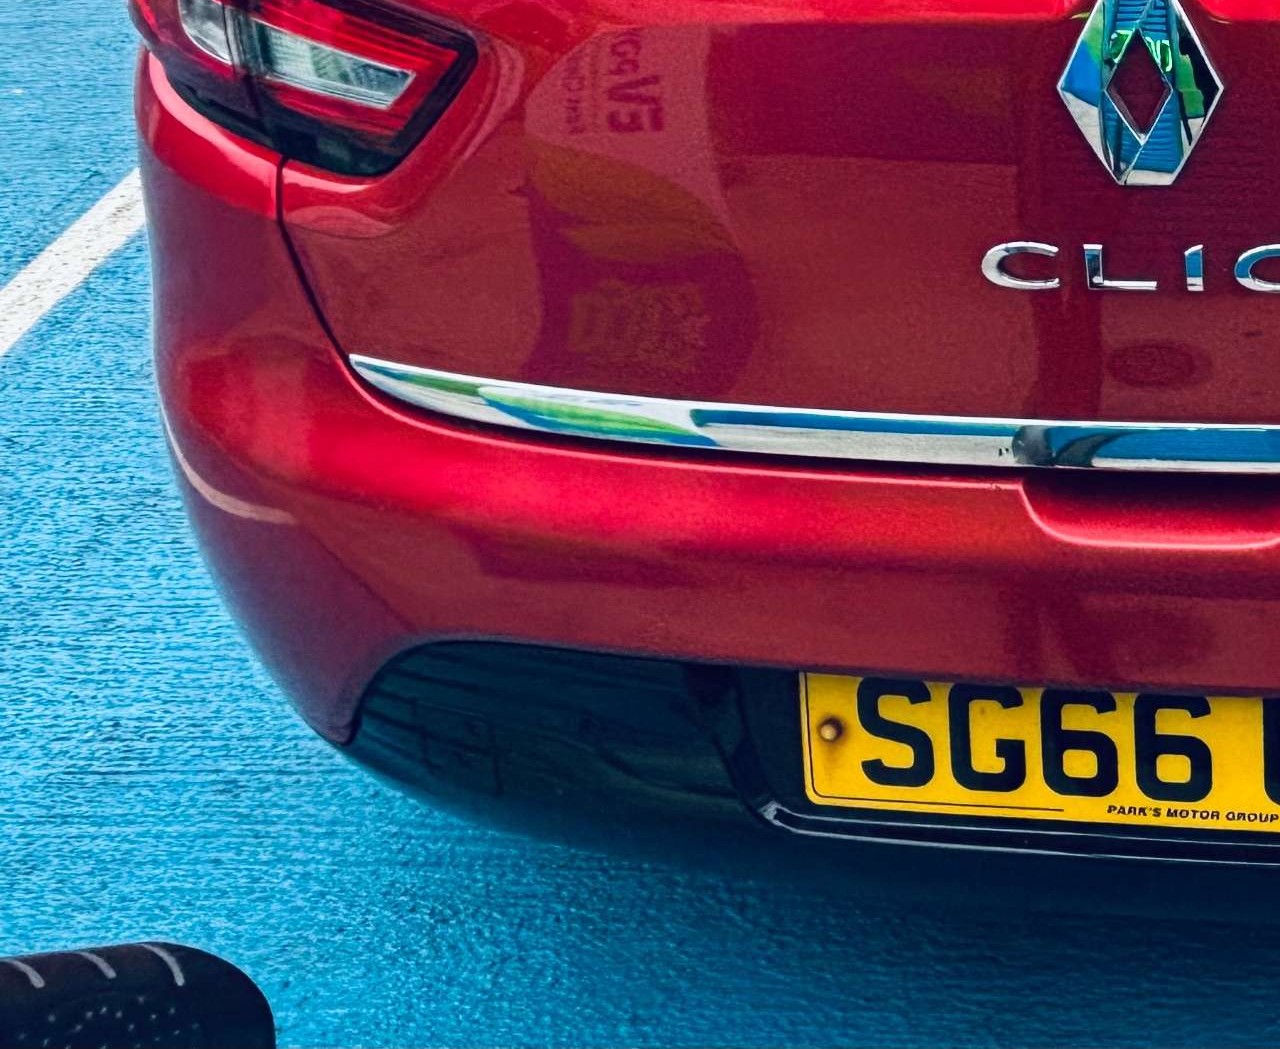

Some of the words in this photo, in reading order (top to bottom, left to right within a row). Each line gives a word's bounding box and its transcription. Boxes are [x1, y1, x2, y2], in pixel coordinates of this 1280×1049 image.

[856, 676, 1213, 803] SG66
[1106, 804, 1162, 818] PARK'S
[1166, 807, 1221, 821] MOTOR
[1225, 810, 1280, 824] GROUP
